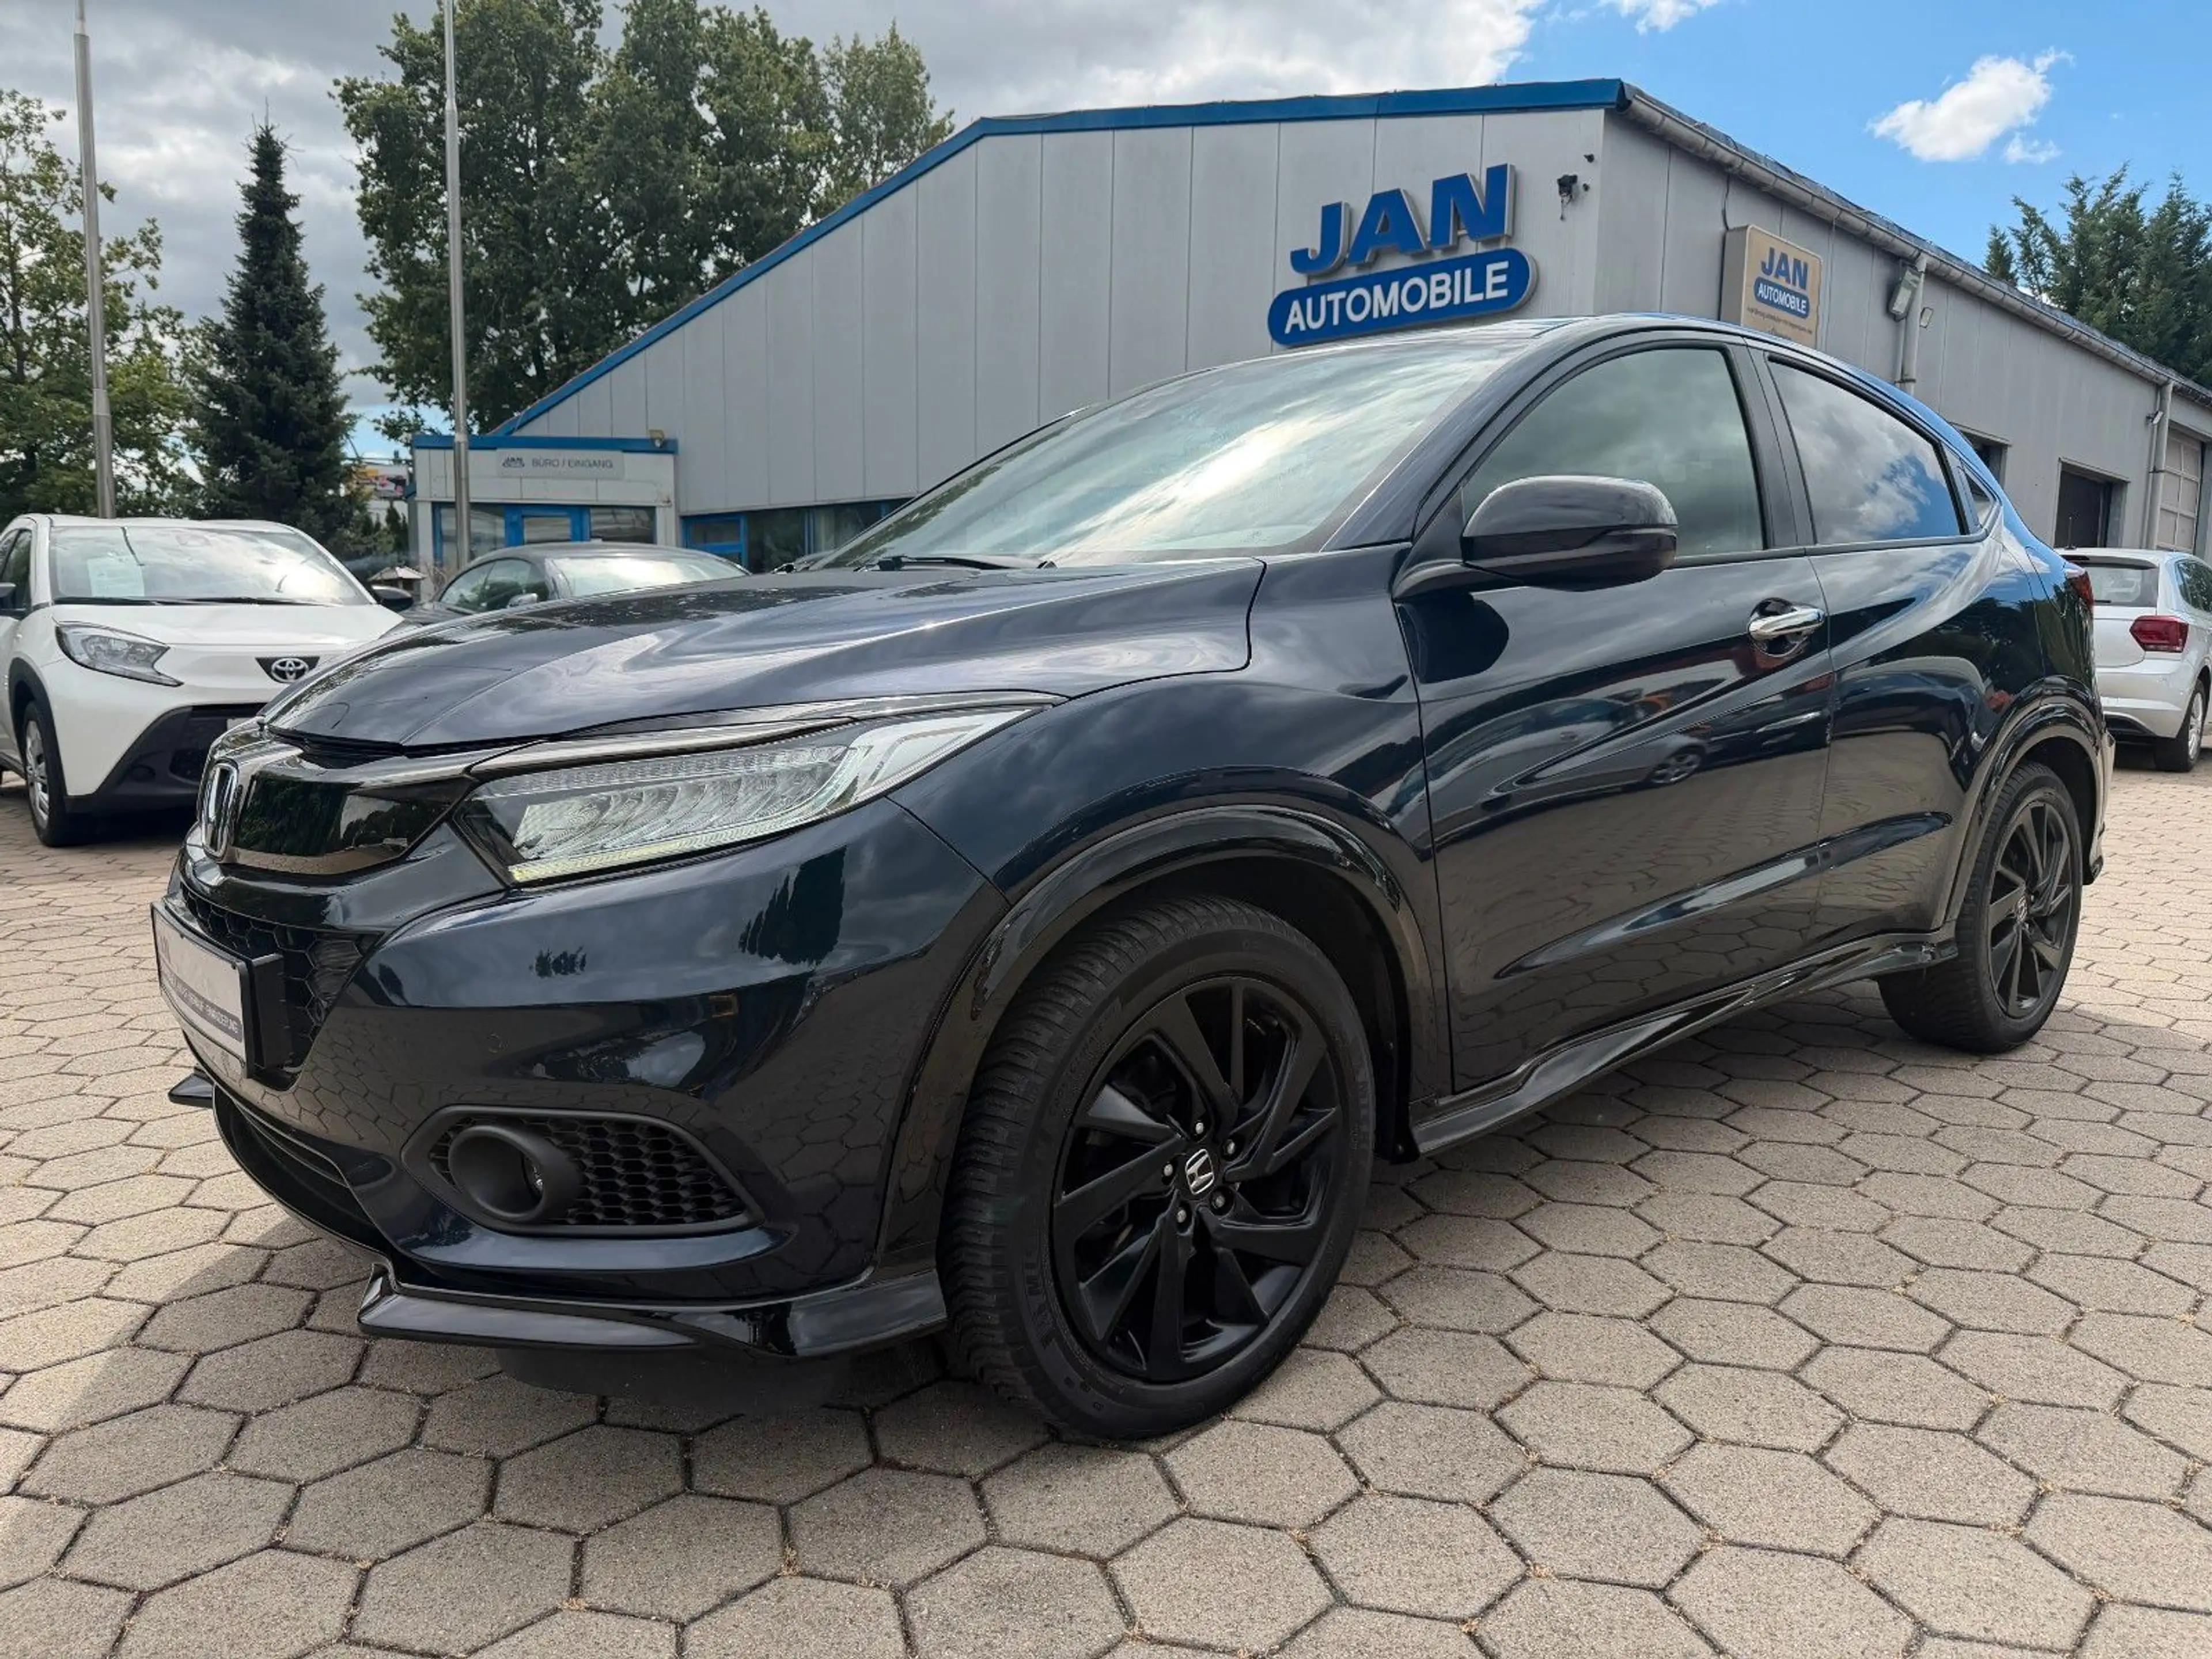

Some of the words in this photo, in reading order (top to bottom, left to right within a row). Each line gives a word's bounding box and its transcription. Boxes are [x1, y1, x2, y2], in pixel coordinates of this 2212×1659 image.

[1290, 163, 1515, 275] JAN
[1761, 247, 1809, 290] JAN
[1285, 261, 1509, 334] AUTOMOBILE
[1758, 283, 1806, 313] AUTOMOBILE
[532, 457, 559, 468] BÜRO
[568, 459, 613, 468] EINGANG
